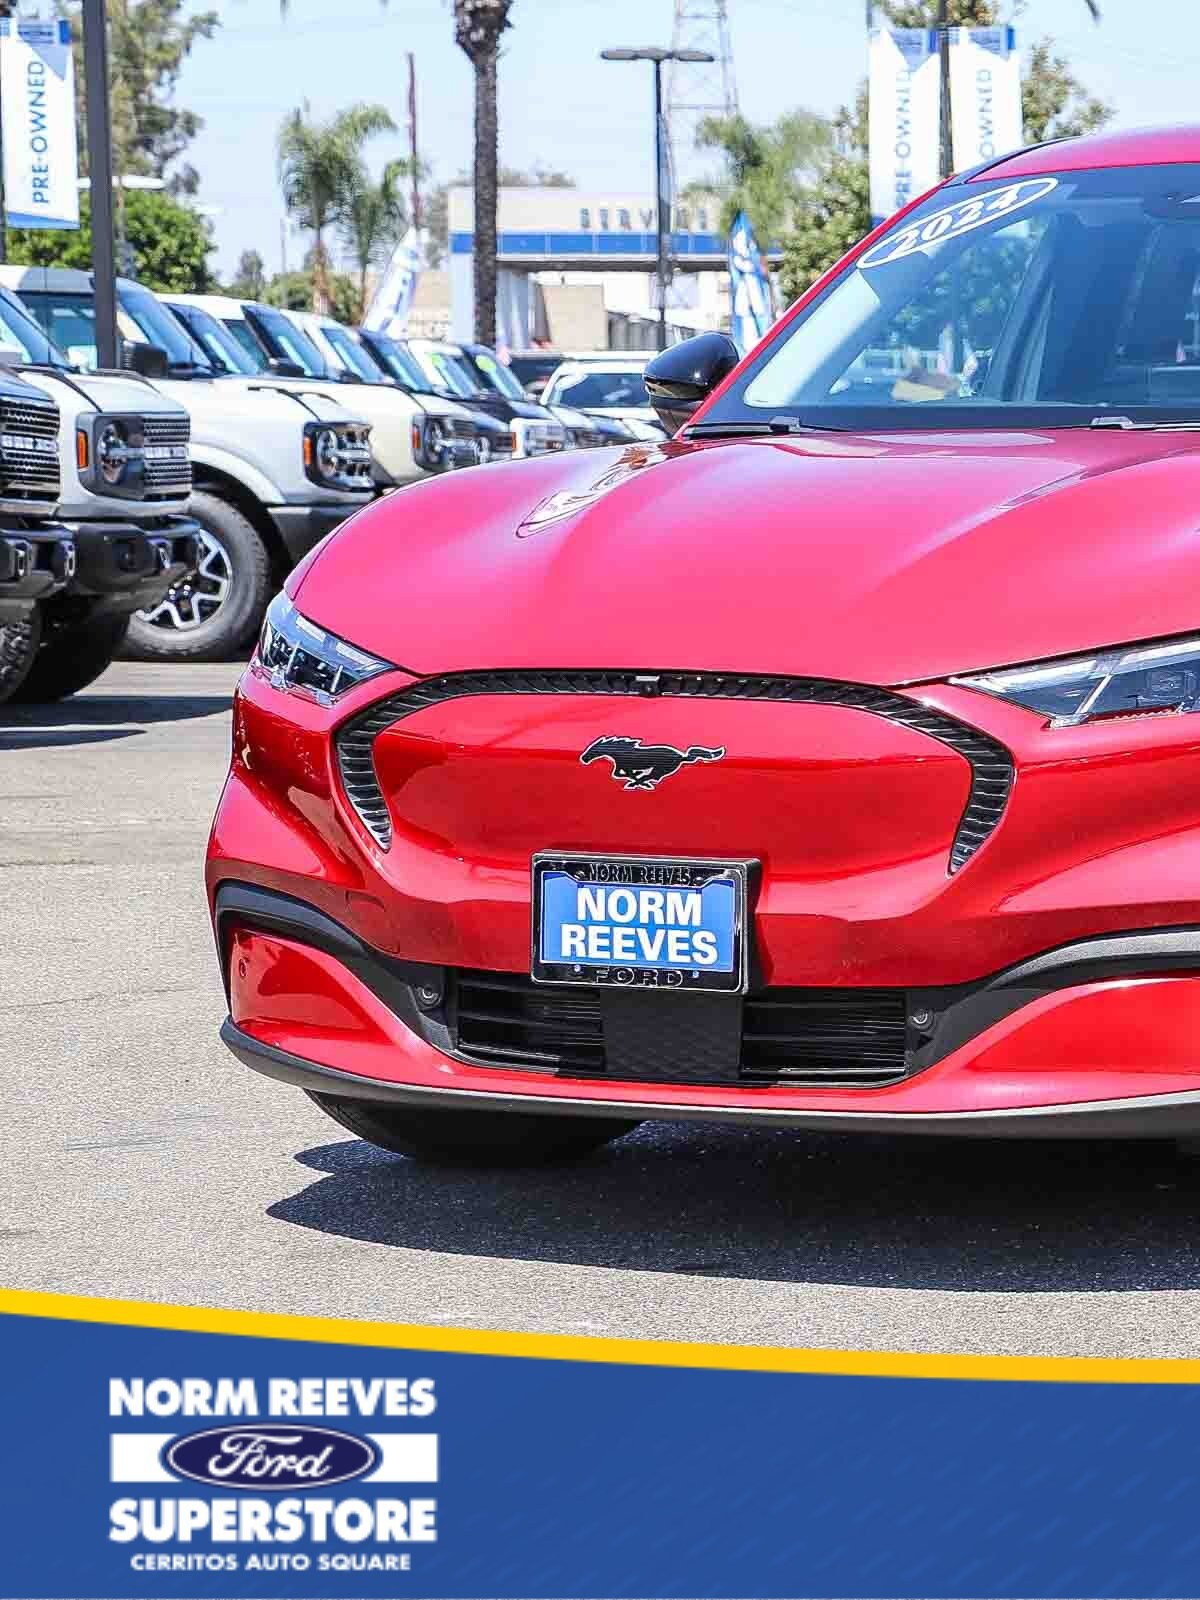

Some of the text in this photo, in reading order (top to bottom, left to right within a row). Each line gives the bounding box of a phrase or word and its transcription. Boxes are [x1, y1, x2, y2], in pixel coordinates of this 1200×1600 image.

[28, 61, 49, 203] PRE-OWNED
[977, 69, 993, 159] OWNED
[579, 206, 708, 231] SERVCE
[888, 184, 1025, 259] 2024
[589, 862, 691, 886] NORM REEVES
[577, 887, 702, 927] NORM
[560, 923, 718, 966] REEVES
[596, 968, 683, 987] FORD
